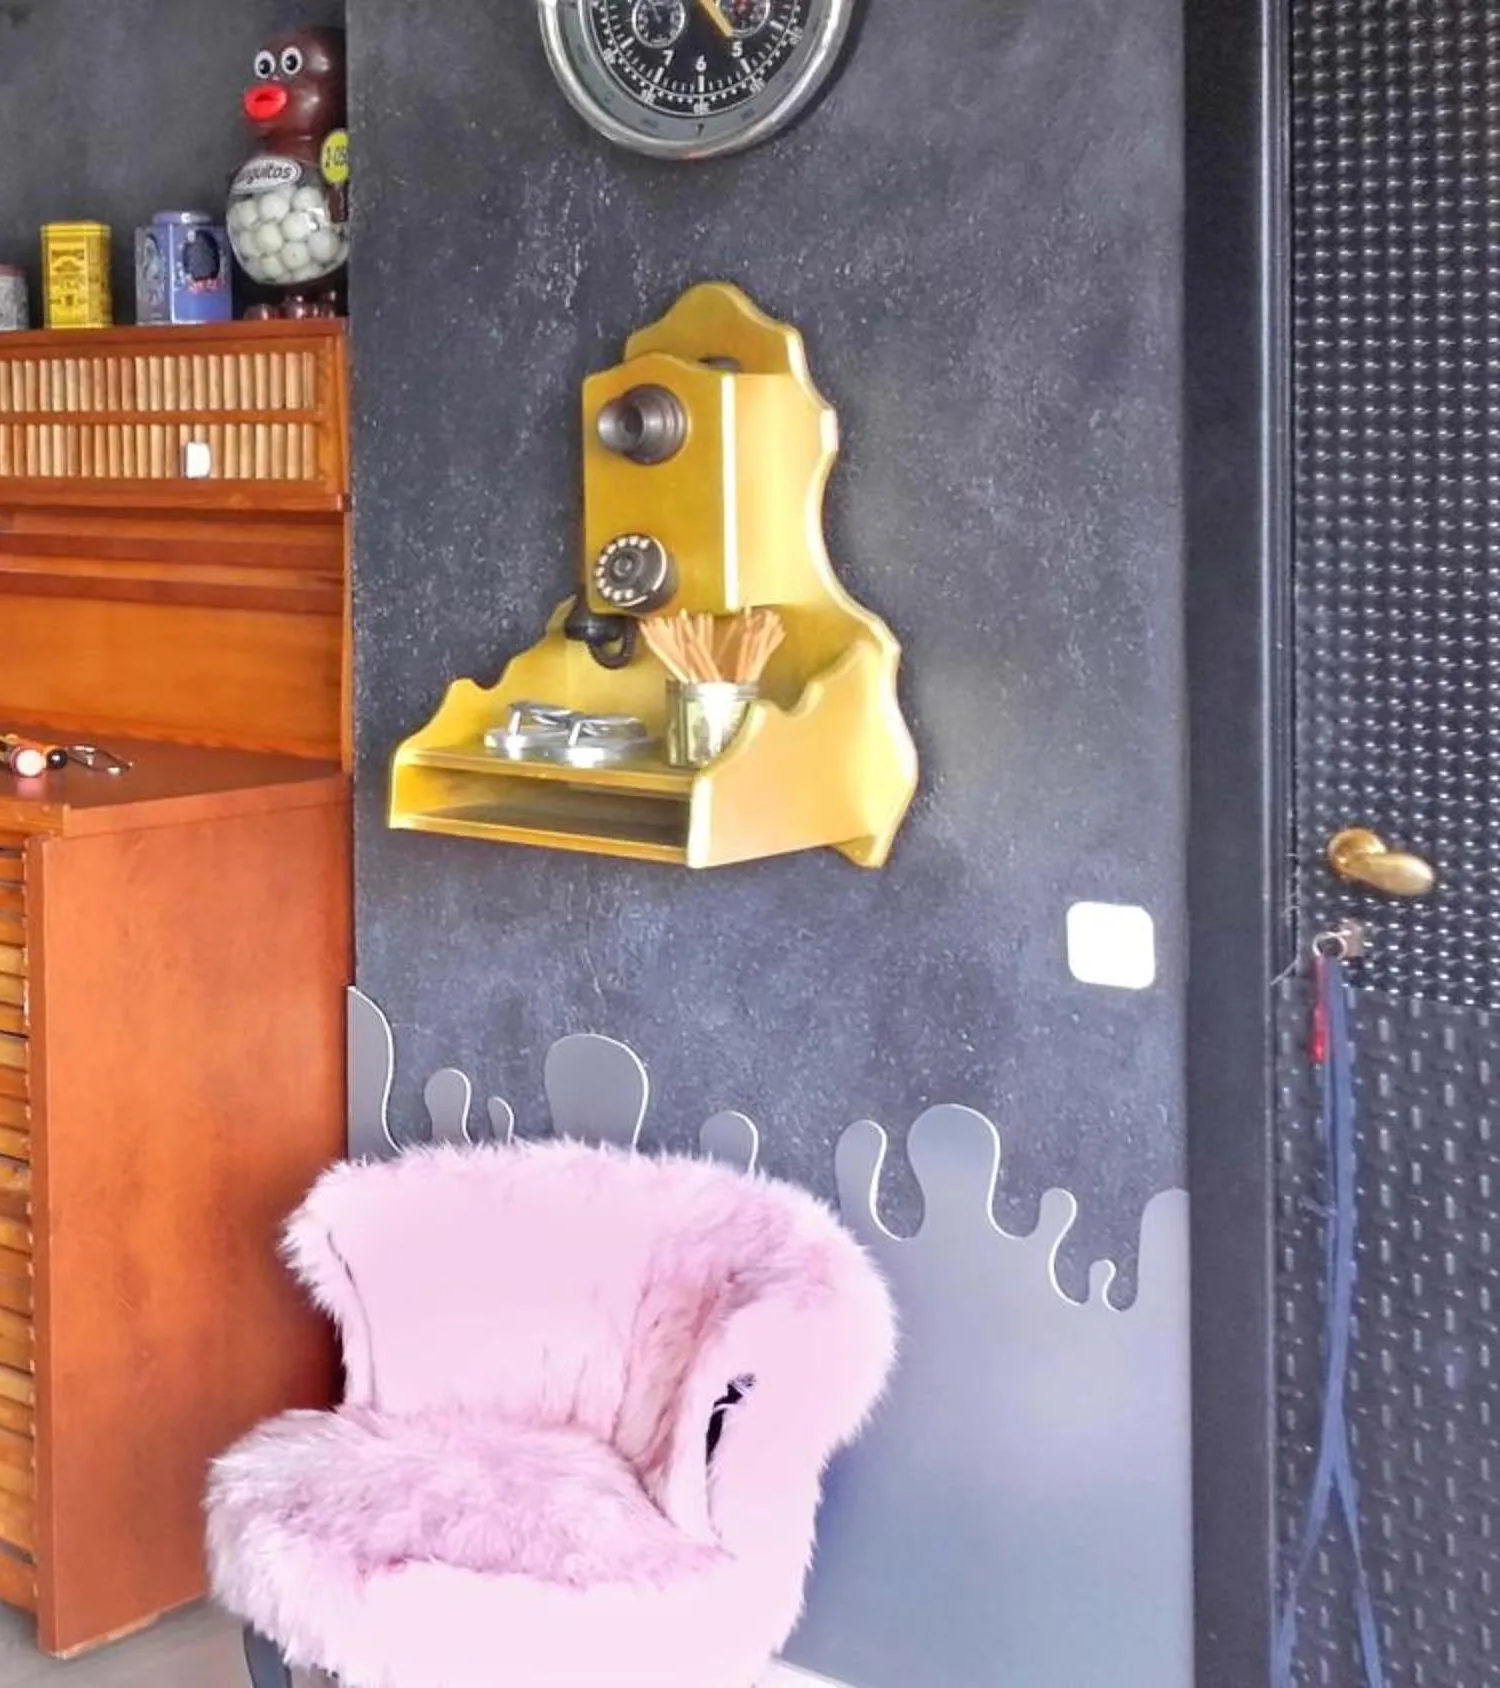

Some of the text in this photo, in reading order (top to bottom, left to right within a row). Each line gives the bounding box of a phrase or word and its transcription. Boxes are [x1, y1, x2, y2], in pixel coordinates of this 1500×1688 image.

[662, 49, 674, 67] 7
[731, 41, 743, 57] 5
[695, 54, 707, 72] 6
